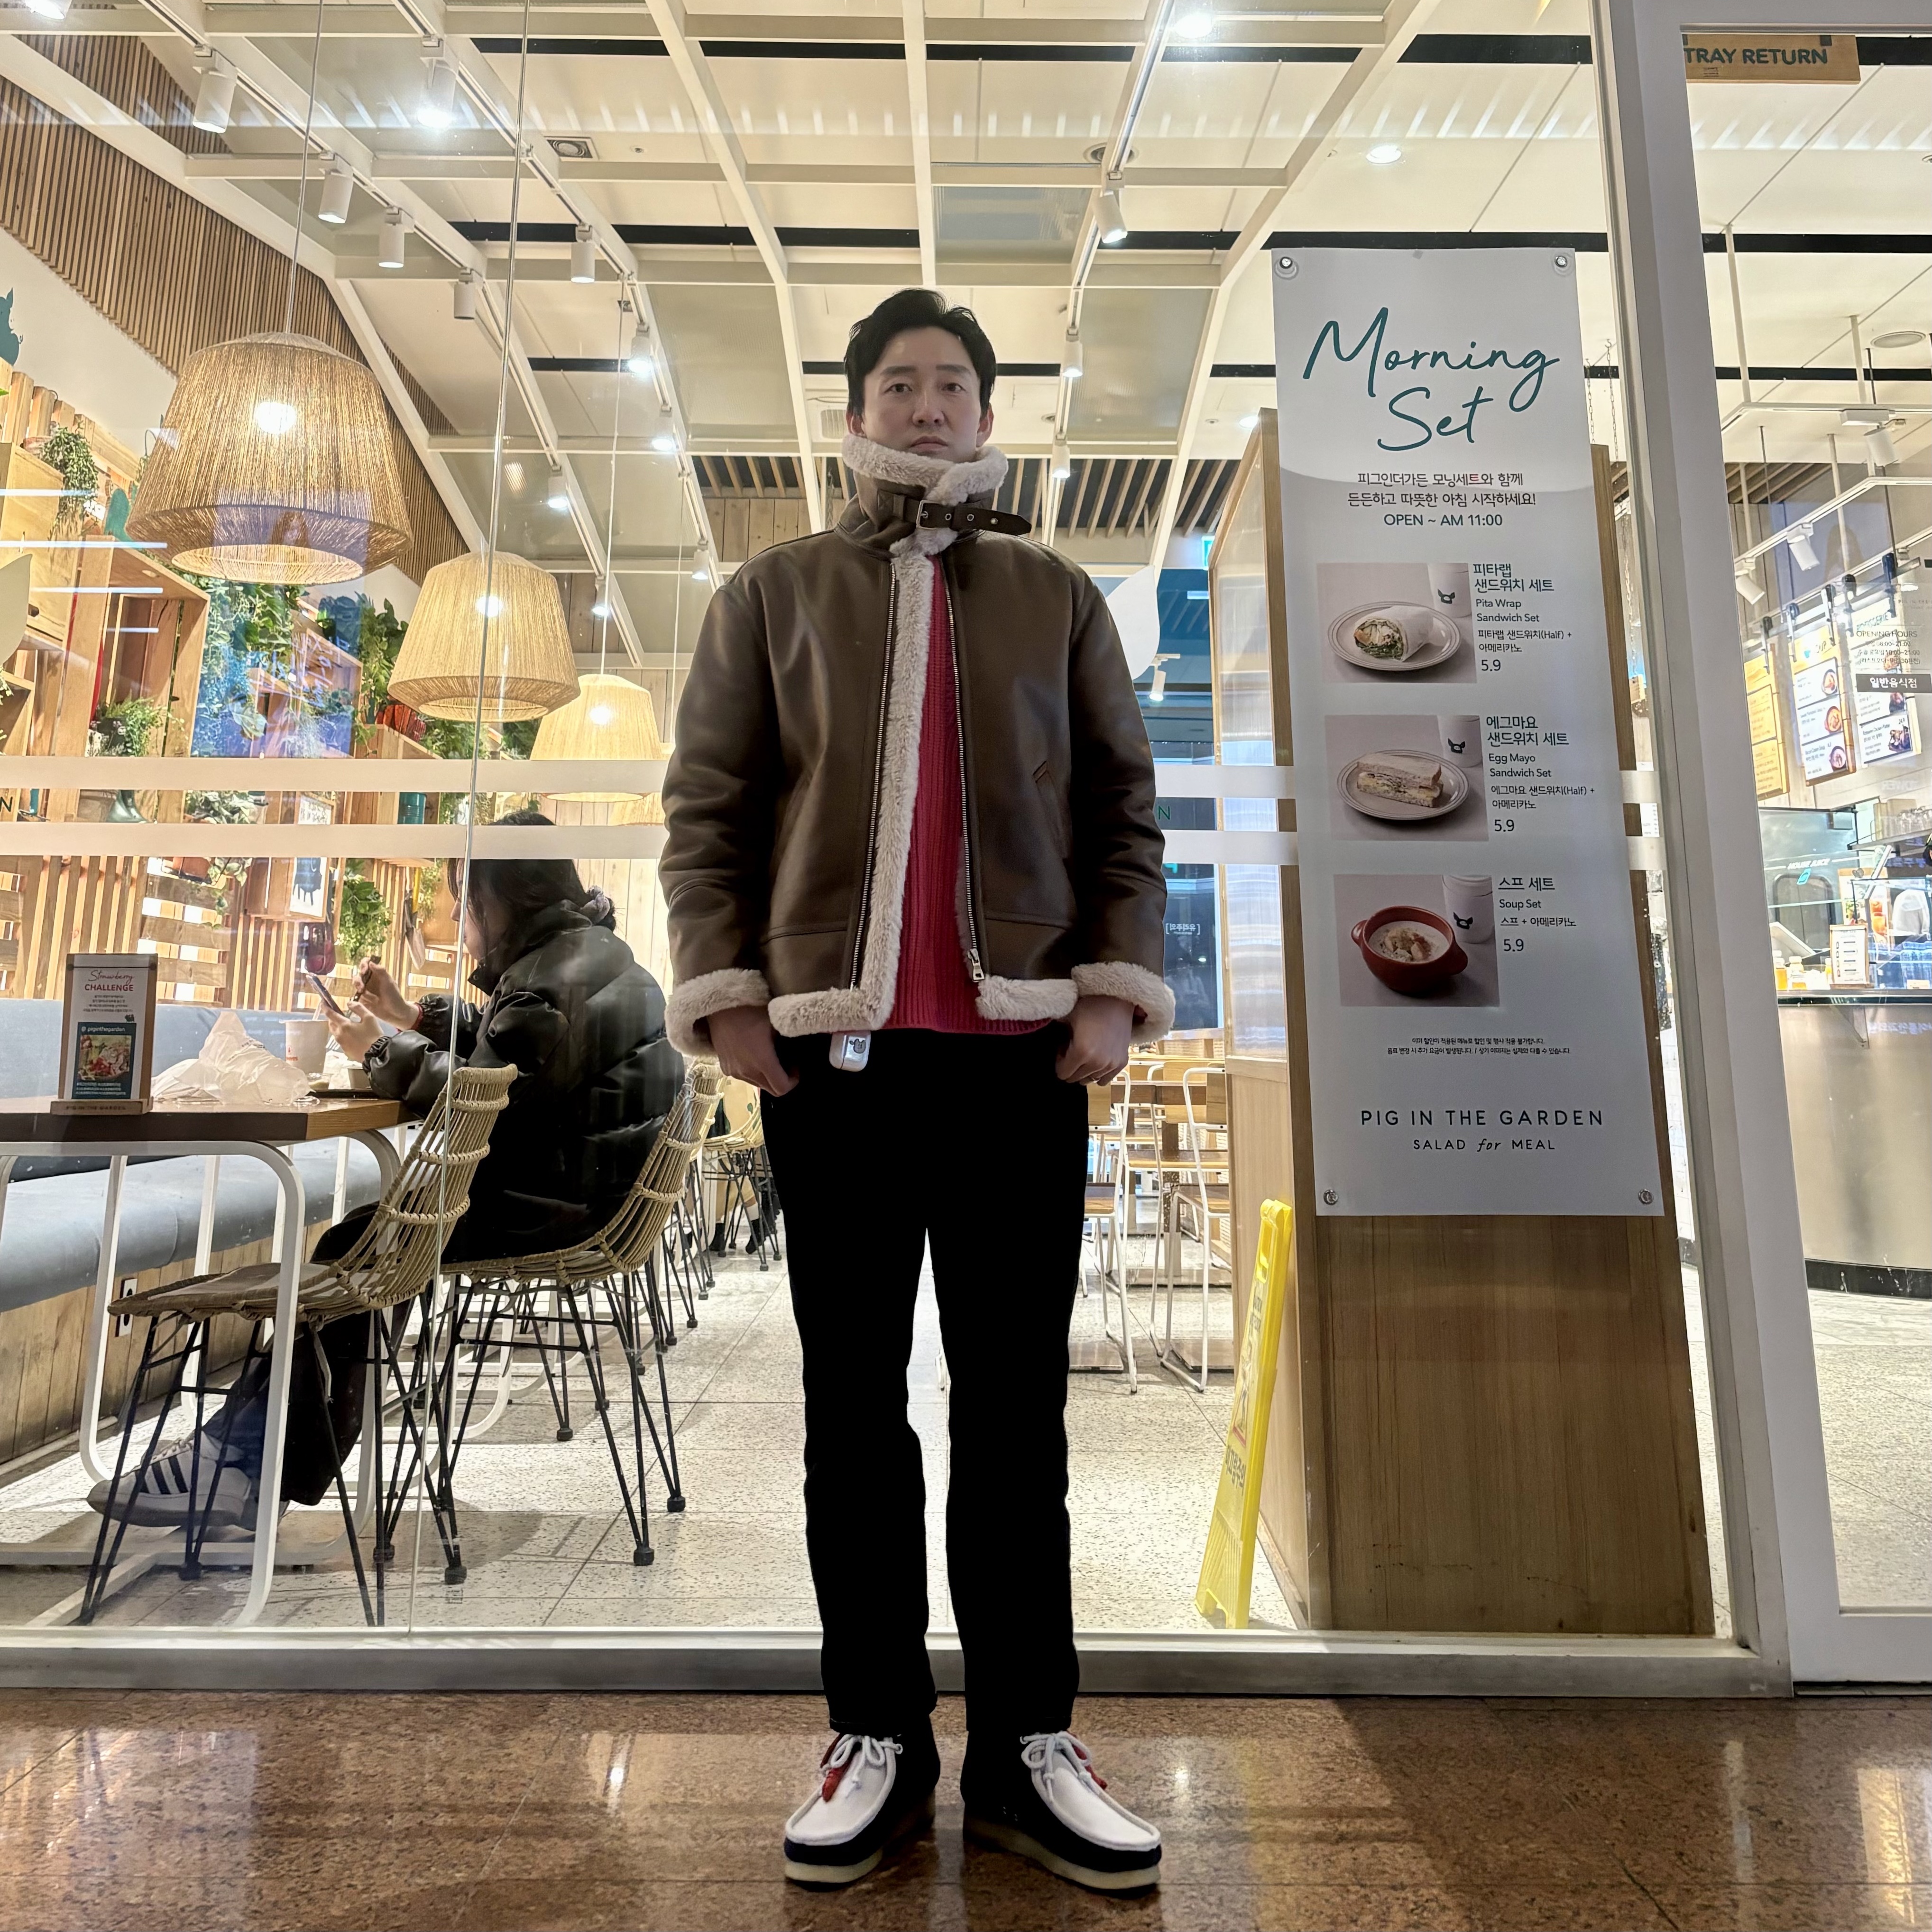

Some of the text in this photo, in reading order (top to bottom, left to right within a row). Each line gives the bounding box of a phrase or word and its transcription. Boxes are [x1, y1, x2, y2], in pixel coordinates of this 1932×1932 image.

[1684, 48, 1828, 65] TRAY RETURN
[1303, 307, 1560, 412] Morning
[1377, 386, 1493, 451] Set
[1357, 473, 1523, 487] 피그인더가든 모닝세트와 함께
[1347, 493, 1536, 507] 든든하고 따뜻한 아침 시작하세요!
[1384, 514, 1423, 526] OPEN
[1440, 514, 1463, 526] AM
[1468, 514, 1503, 526] 11:00
[1473, 563, 1512, 578] 피타랩
[1474, 578, 1555, 593] 샌드위치 세트
[1476, 599, 1522, 610] Pita Wrap
[1476, 613, 1540, 622] Sandwich Set
[1478, 630, 1504, 640] 피타랩
[1507, 630, 1564, 640] 샌드위치(Half)
[1479, 643, 1522, 652] 아메리카노
[1481, 659, 1501, 672] 5.9
[1869, 677, 1917, 688] 일반음식점
[1486, 716, 1538, 729] 에그마요
[1487, 732, 1569, 747] 샌드위치 세트
[1489, 753, 1536, 764] Egg Mayo
[1490, 768, 1552, 777] Sandwich Set
[1491, 785, 1527, 795] 에그마요
[1528, 786, 1587, 797] 샌드위치(Half)
[1492, 800, 1536, 809] 아메리카노
[1494, 819, 1515, 832] 5.9
[1498, 877, 1555, 891] 스프 세트
[1499, 899, 1541, 911] Soup Set
[1500, 917, 1519, 926] 스프
[1530, 917, 1577, 927] 아메리카노
[1503, 939, 1524, 952] 5.9
[88, 970, 134, 986] Strawberry
[1361, 1110, 1602, 1126] PIG IN THE GARDEN
[1413, 1138, 1555, 1152] SALAD for MEAL
